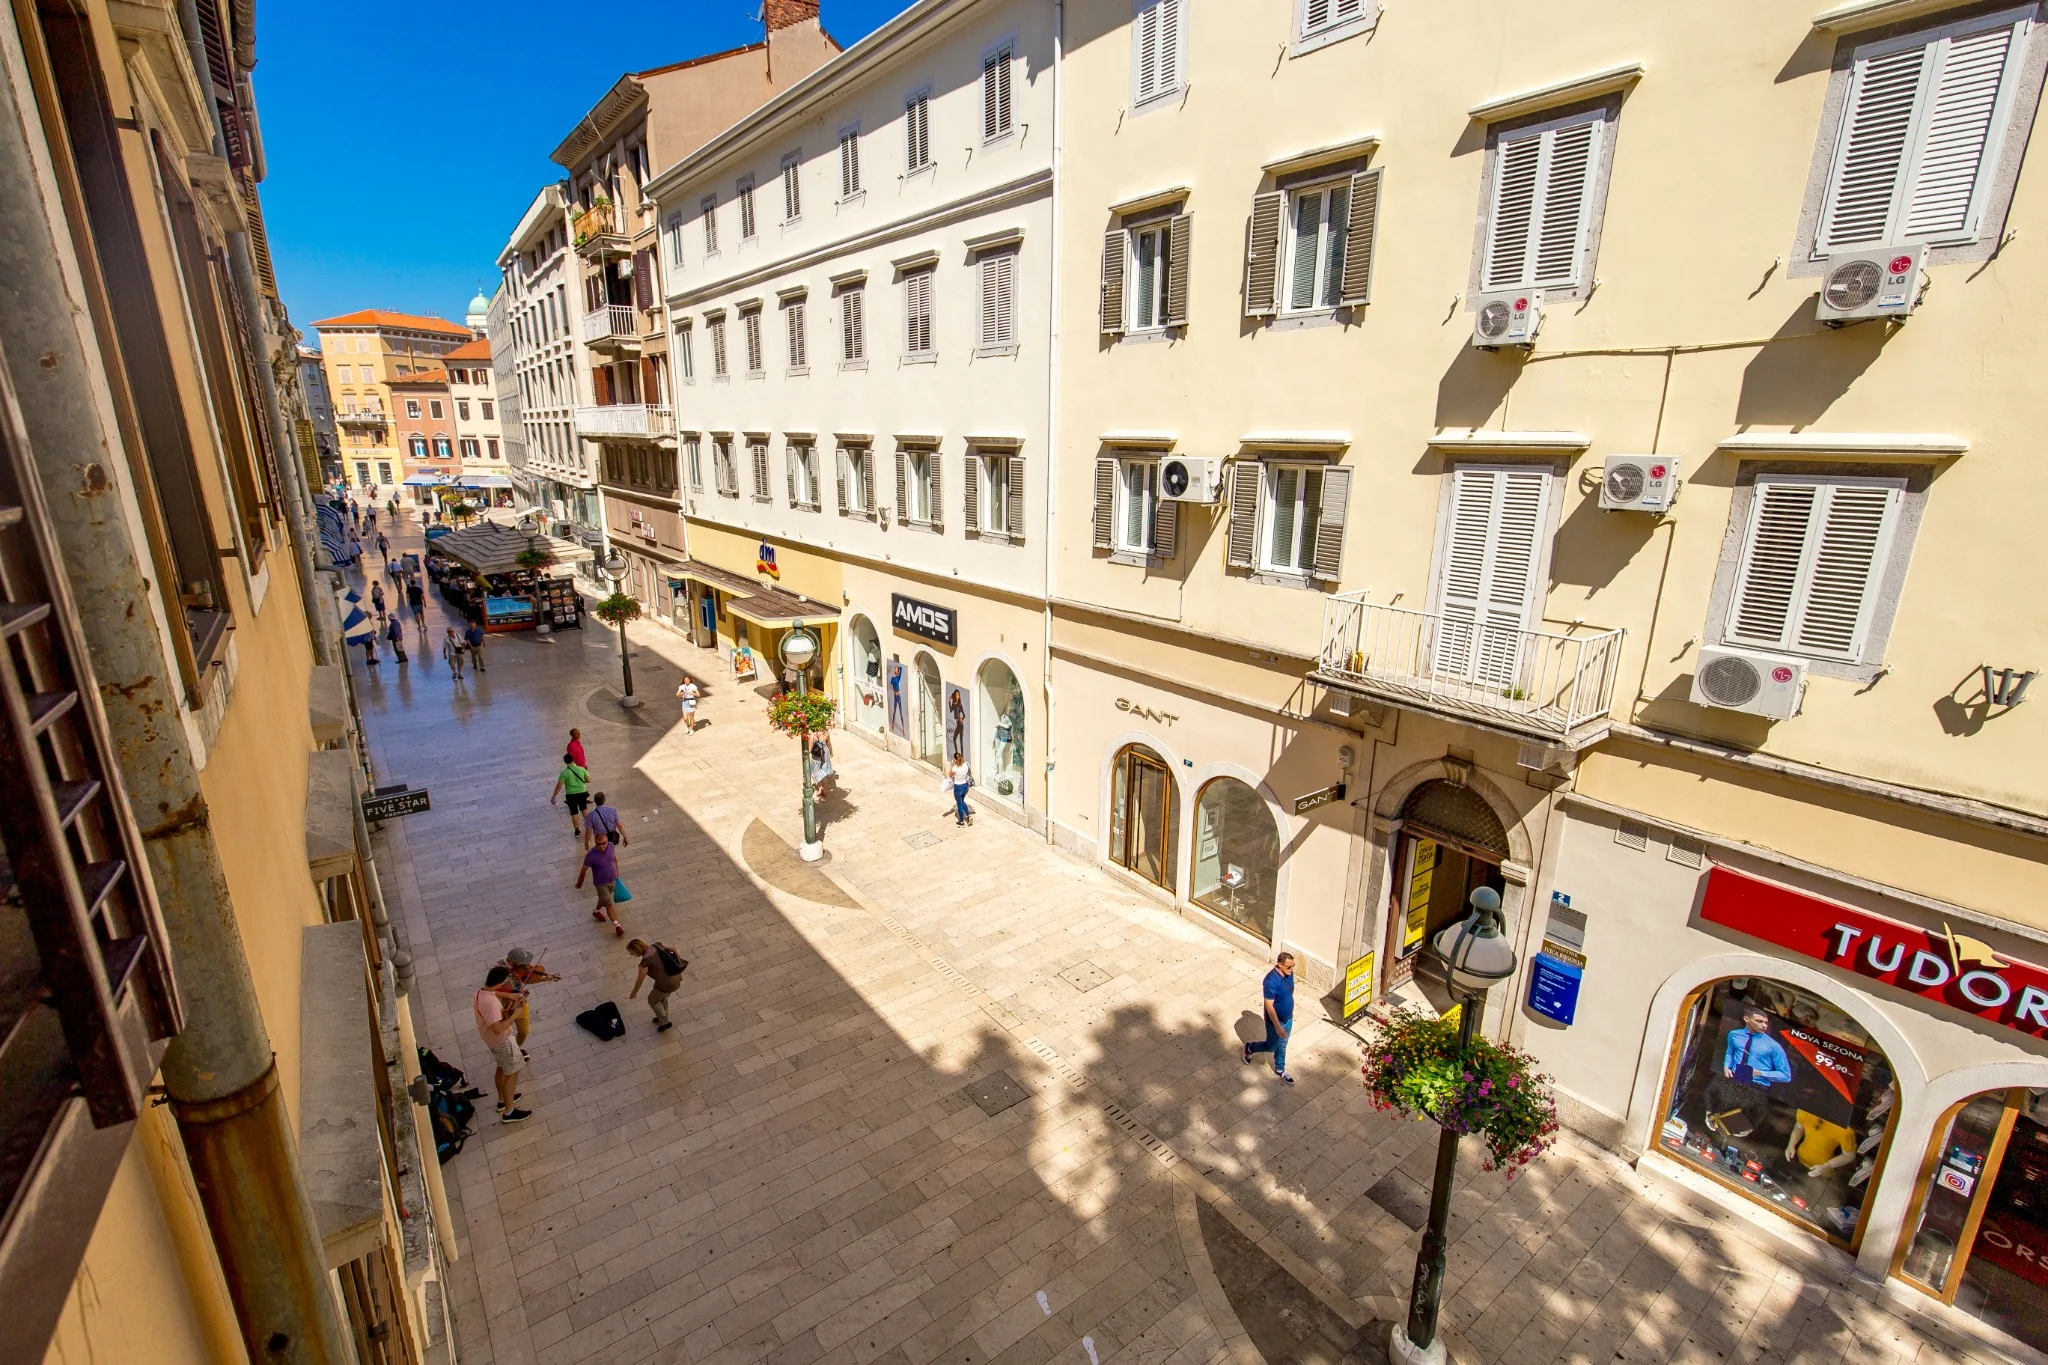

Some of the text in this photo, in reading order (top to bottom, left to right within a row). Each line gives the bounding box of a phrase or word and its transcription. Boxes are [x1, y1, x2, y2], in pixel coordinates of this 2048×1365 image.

[1888, 275, 1906, 285] LG
[759, 537, 775, 564] dm
[1114, 697, 1179, 727] GANT
[367, 798, 428, 816] FIVE STAR
[1298, 790, 1336, 810] GANT
[384, 809, 413, 818] FASHION
[1558, 893, 1565, 903] 2
[1834, 922, 2048, 1028] TUDOR
[1791, 1029, 1820, 1045] NOVA
[1822, 1041, 1864, 1062] SEZONA
